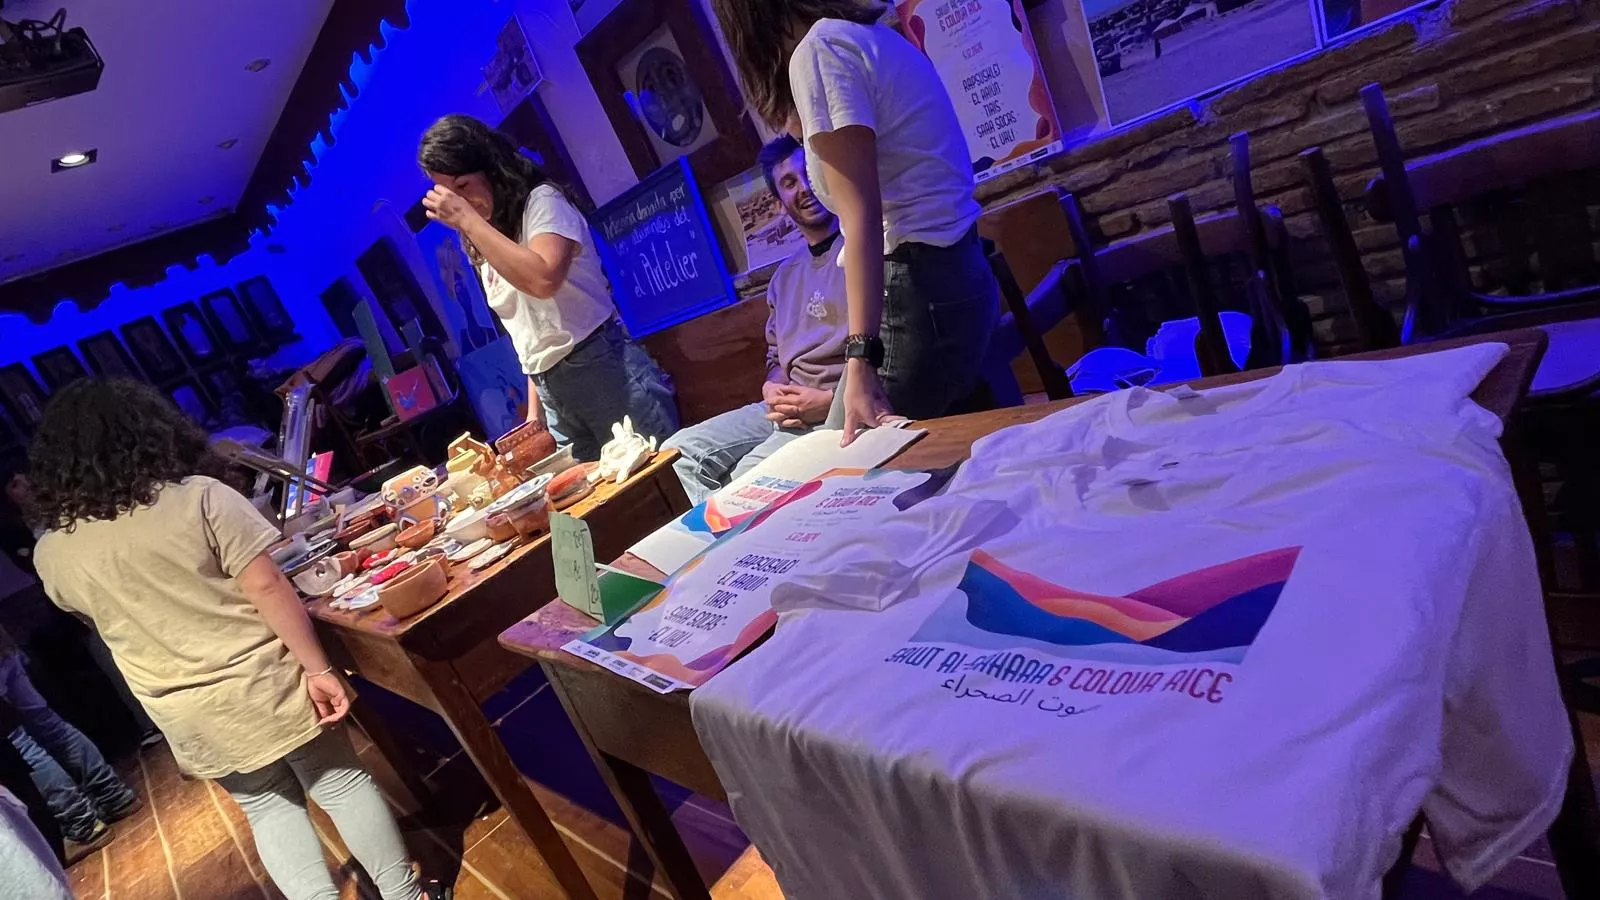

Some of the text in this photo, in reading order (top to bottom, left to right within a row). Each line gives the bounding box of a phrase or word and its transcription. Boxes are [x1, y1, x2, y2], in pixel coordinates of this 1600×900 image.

[971, 92, 981, 105] EL
[976, 110, 1017, 138] SARA SOCAS
[990, 135, 1001, 149] EL
[716, 570, 738, 586] EL
[663, 604, 728, 631] SARA SOCAS
[648, 625, 672, 642] EL
[884, 646, 945, 669] SAWT
[1047, 665, 1072, 687] &
[1069, 667, 1164, 695] COLOUR
[1161, 667, 1233, 704] RICE
[940, 673, 1035, 706] الصحراء
